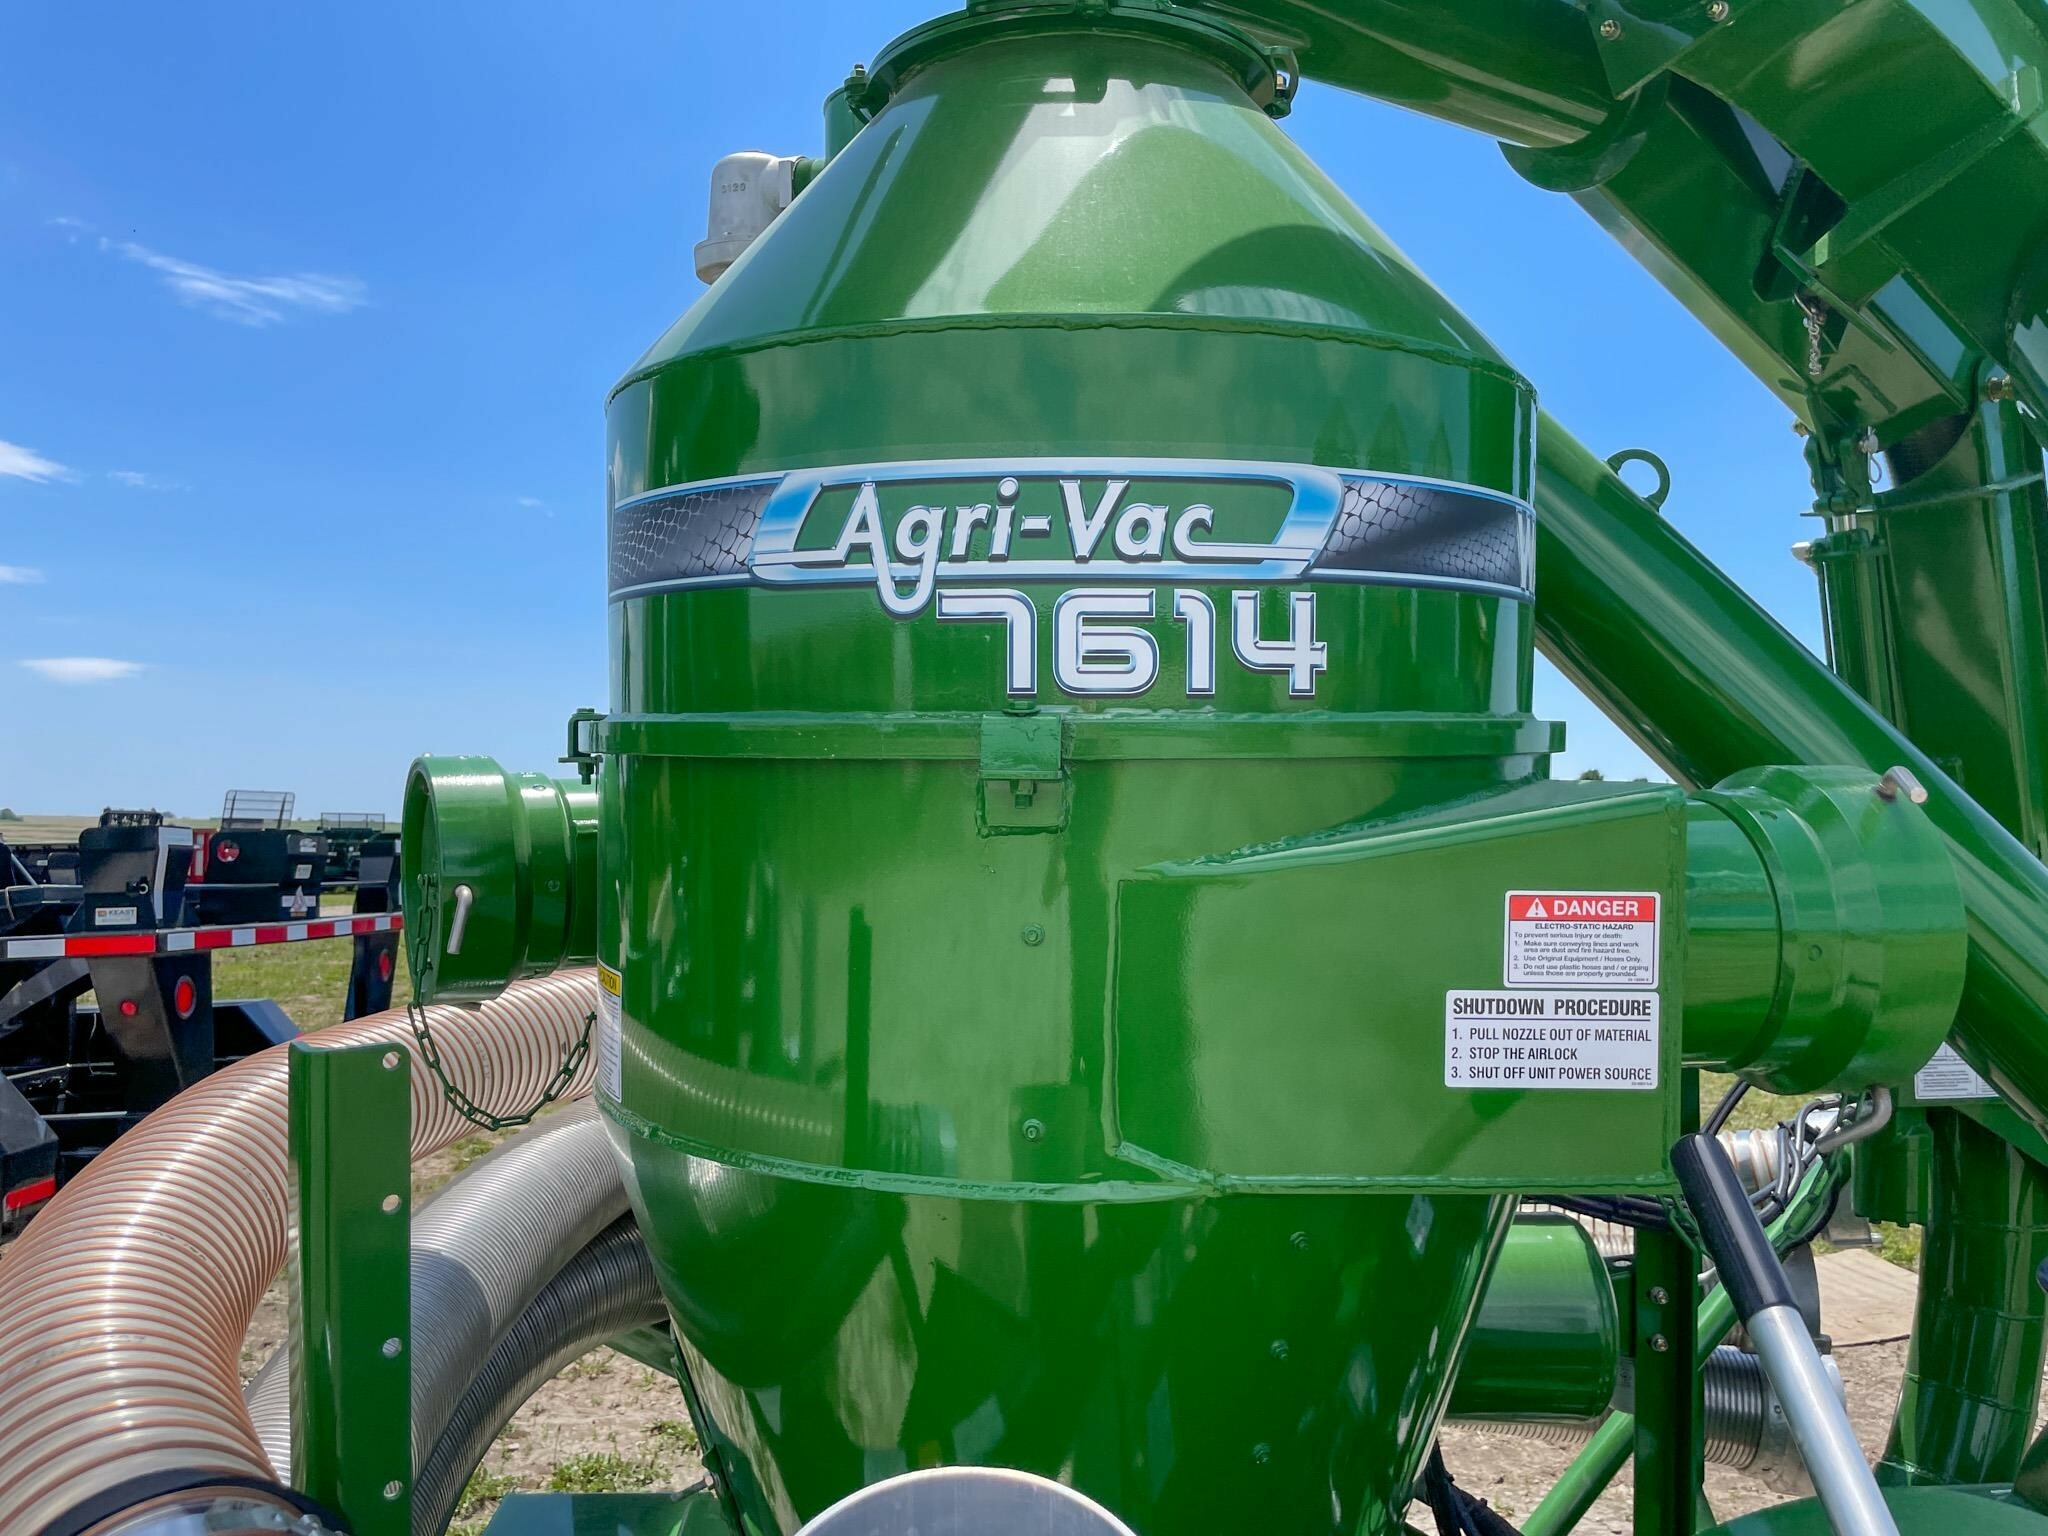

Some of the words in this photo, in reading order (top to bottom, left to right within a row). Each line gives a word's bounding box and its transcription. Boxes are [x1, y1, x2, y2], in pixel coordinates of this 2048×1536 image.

[836, 476, 1214, 614] Agri-Vac
[936, 588, 1327, 695] 7614
[1554, 900, 1639, 916] DANGER
[1453, 998, 1544, 1015] SHUTDOWN
[1554, 999, 1651, 1016] PROCEDURE
[1452, 1029, 1462, 1039] 1.
[1470, 1028, 1499, 1040] PULL
[1502, 1028, 1546, 1040] NOZZLE
[1550, 1029, 1573, 1041] OUT
[1576, 1029, 1591, 1041] OF
[1595, 1029, 1652, 1041] MATERIAL
[1452, 1048, 1462, 1059] 2.
[1469, 1047, 1499, 1059] STOP
[1503, 1048, 1524, 1059] THE
[1528, 1048, 1578, 1060] AIRLOCK
[1451, 1067, 1462, 1078] 3.
[1469, 1067, 1500, 1078] SHUT
[1503, 1067, 1525, 1078] OFF
[1529, 1067, 1555, 1079] UNIT
[1559, 1068, 1600, 1079] POWER
[1604, 1068, 1651, 1080] SOURCE
